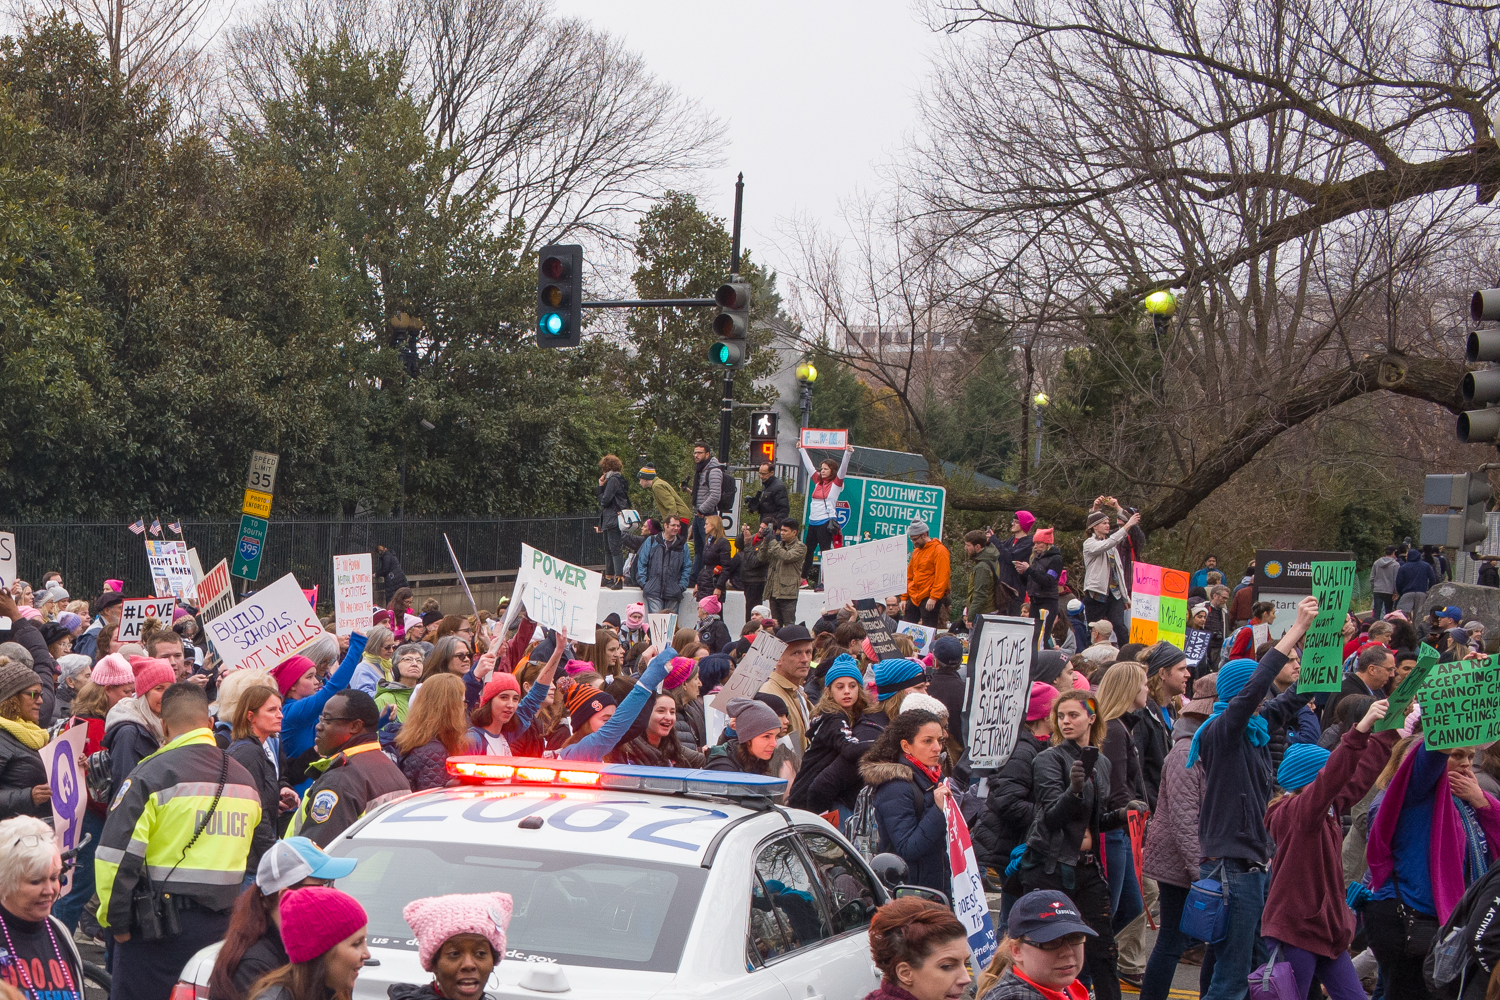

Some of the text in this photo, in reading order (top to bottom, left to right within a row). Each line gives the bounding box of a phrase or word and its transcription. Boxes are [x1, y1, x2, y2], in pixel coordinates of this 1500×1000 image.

[254, 455, 275, 466] SPEED
[762, 443, 773, 461] 9
[255, 465, 272, 473] LIMIT
[251, 472, 271, 487] 35
[870, 484, 938, 504] SOUTHWEST
[246, 501, 268, 512] ENFORCED
[869, 504, 935, 523] SOUTHEAST
[243, 527, 263, 537] SOUTH
[251, 520, 259, 528] TO
[241, 543, 257, 556] 395
[855, 546, 867, 559] I
[150, 557, 173, 566] RIGHTS
[532, 549, 587, 590] POWER
[852, 560, 881, 575] GOD
[170, 567, 192, 576] WOMEN
[1312, 564, 1356, 587] QUALITY
[197, 562, 229, 609] CIVILITY
[539, 579, 567, 597] to the
[827, 586, 852, 607] AND
[1318, 589, 1344, 611] MEN
[123, 602, 174, 619] #LOVE
[532, 587, 584, 637] PEOPLE
[1161, 603, 1186, 628] Mother
[212, 604, 265, 642] BUILD
[1315, 615, 1335, 629] want
[235, 649, 266, 670] NOT
[266, 617, 322, 658] WALLS
[1185, 630, 1198, 657] OFF MY
[1191, 631, 1206, 659] LAWS
[1304, 632, 1343, 649] EQUALITY
[983, 637, 993, 667] A
[1312, 653, 1324, 666] for
[1298, 665, 1338, 686] WOMEN
[1437, 661, 1463, 676] AM
[1420, 670, 1493, 690] ACCEPTING
[1418, 684, 1484, 703] I CANNOT
[1420, 696, 1500, 716] I AM CHANG
[1422, 708, 1497, 728] THE THINGS
[1427, 725, 1483, 747] CANNOT
[194, 809, 248, 838] POLICE
[380, 792, 729, 852] 2062
[1474, 907, 1497, 941] ACTIVISM
[371, 937, 389, 945] us
